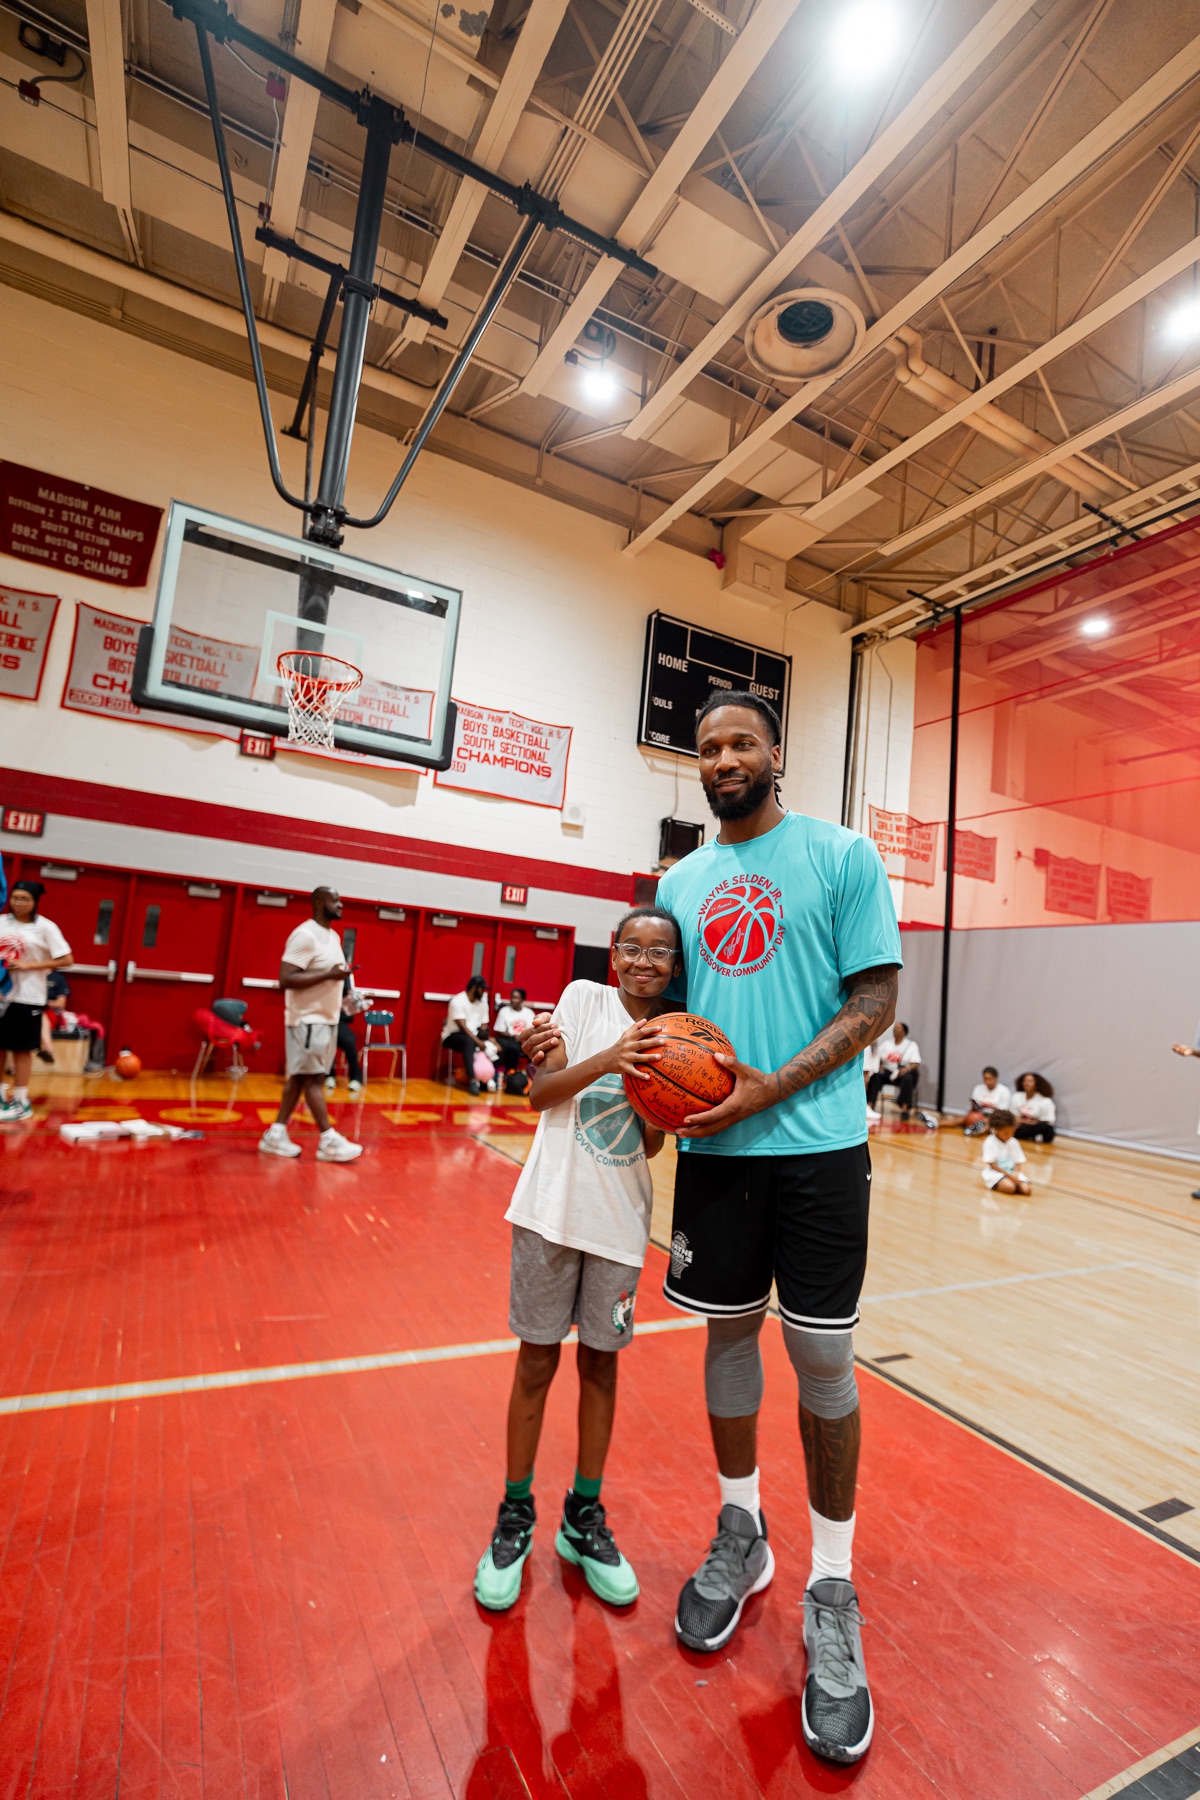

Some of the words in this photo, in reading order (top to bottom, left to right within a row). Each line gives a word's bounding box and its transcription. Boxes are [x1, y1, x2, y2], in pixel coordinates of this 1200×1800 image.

[38, 487, 89, 511] MADISON
[94, 504, 122, 521] PARK
[8, 495, 46, 515] DIVISION
[61, 510, 95, 529] STATE
[99, 521, 144, 543] CHAMPS
[12, 522, 38, 540] 1982
[45, 534, 78, 551] BOSTON
[82, 545, 101, 557] CITY
[108, 550, 132, 566] 1982
[41, 520, 69, 535] SOUTH
[74, 529, 111, 547] SECTION
[64, 553, 129, 579] CO-CHAMPS
[94, 617, 135, 636] MADISON
[103, 636, 138, 657] BOYS
[164, 650, 229, 678] SKETBALL
[107, 657, 132, 675] BOST
[658, 652, 689, 673] HOME
[708, 675, 733, 690] PERIOD
[750, 682, 780, 701] GUEST
[368, 714, 394, 731] CITY
[487, 713, 504, 724] PARK
[462, 718, 489, 736] BOYS
[492, 725, 551, 751] BASKETBALL
[649, 731, 671, 745] CORE
[247, 737, 271, 757] EXIT
[463, 733, 495, 752] SOUTH
[500, 741, 548, 764] SECTIONAL
[456, 746, 552, 778] CHAMPIONS
[7, 811, 40, 833] EXIT
[505, 885, 525, 903] EXIT
[698, 880, 729, 916] WAYNE
[732, 874, 773, 890] SELDEN
[769, 887, 783, 904] JR.
[732, 944, 779, 978] COMMUNITY
[773, 923, 787, 946] DAY
